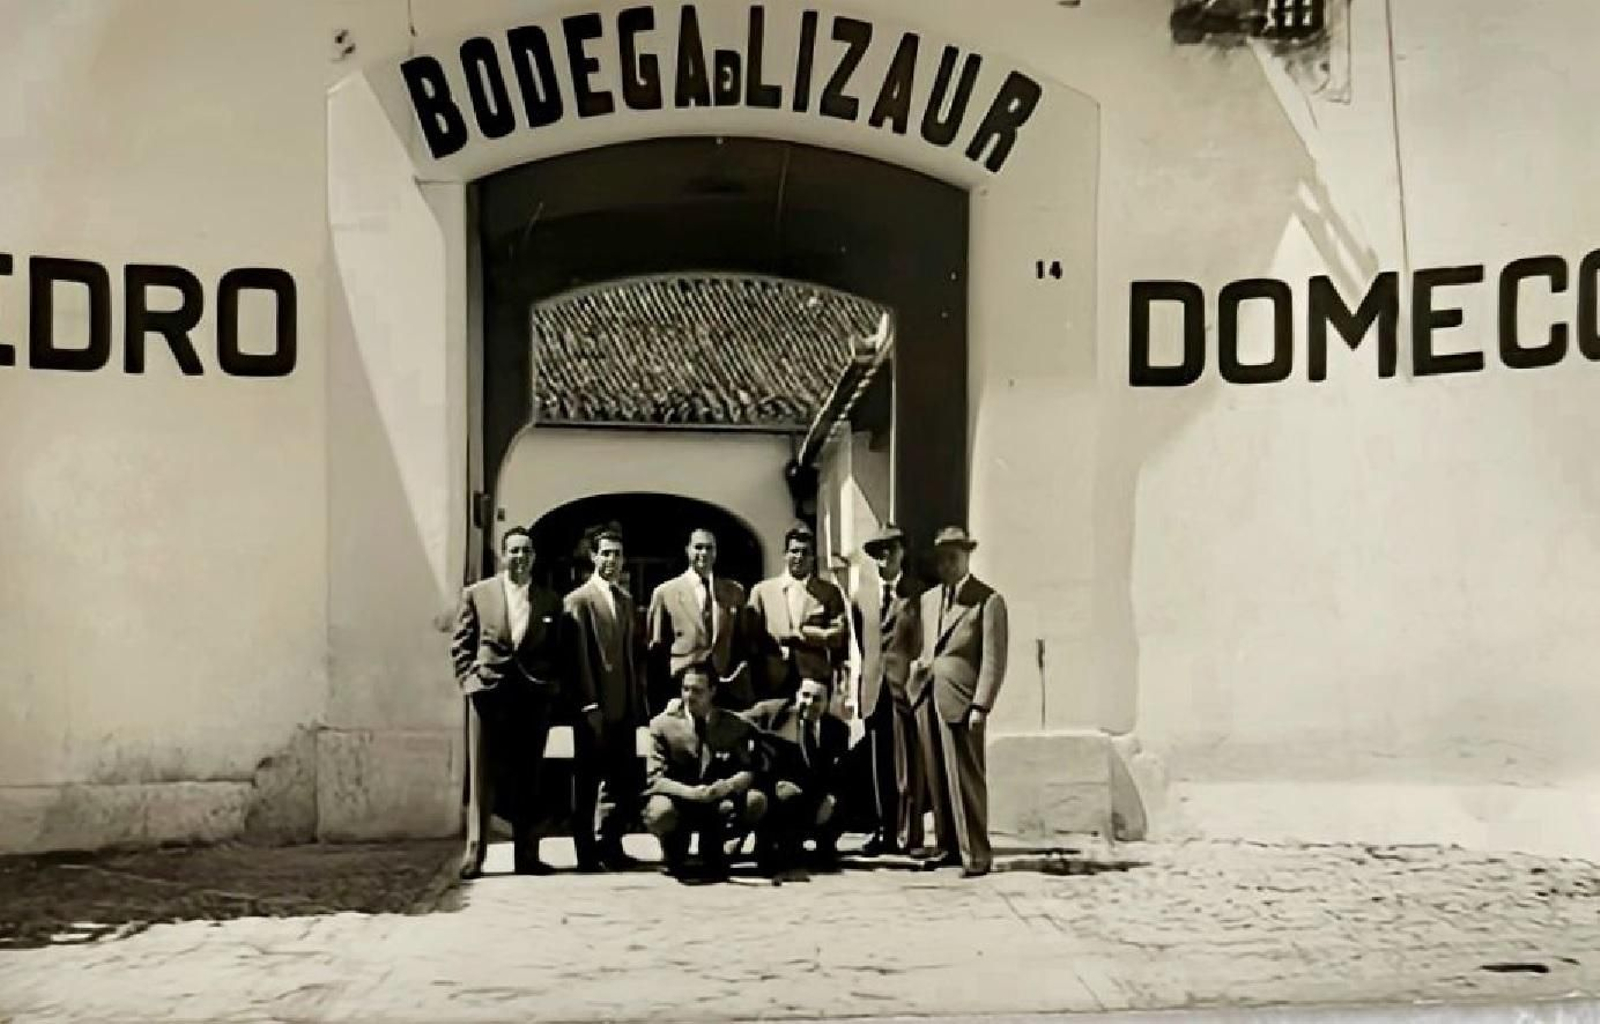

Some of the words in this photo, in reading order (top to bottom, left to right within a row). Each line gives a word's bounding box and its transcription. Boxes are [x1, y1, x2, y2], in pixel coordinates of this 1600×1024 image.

[399, 4, 713, 160] BODEGA
[744, 5, 1043, 173] LIZAUR
[0, 253, 297, 378] DRO
[1036, 259, 1063, 280] 14
